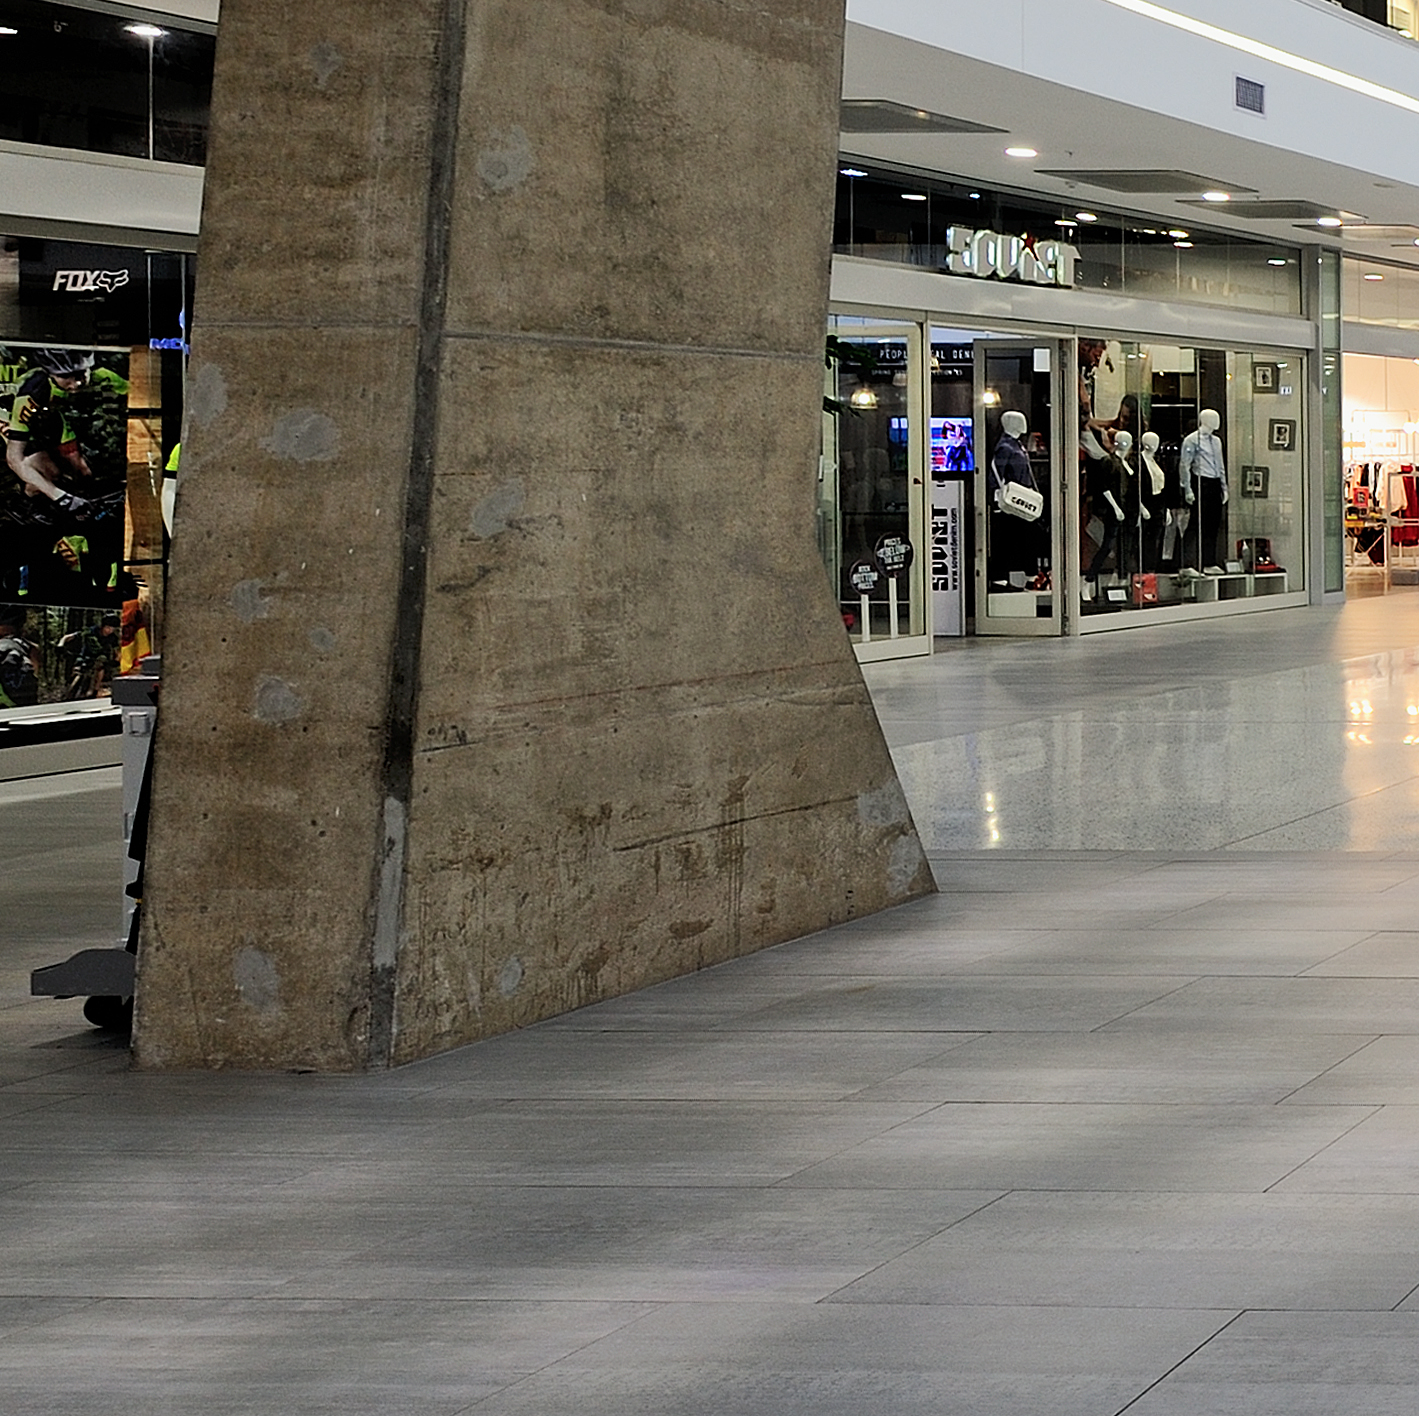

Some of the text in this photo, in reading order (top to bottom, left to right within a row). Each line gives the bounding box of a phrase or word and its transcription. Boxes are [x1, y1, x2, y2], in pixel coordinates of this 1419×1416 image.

[53, 270, 100, 291] FOX
[880, 349, 908, 359] PEOPL
[931, 504, 949, 591] SOVIET
